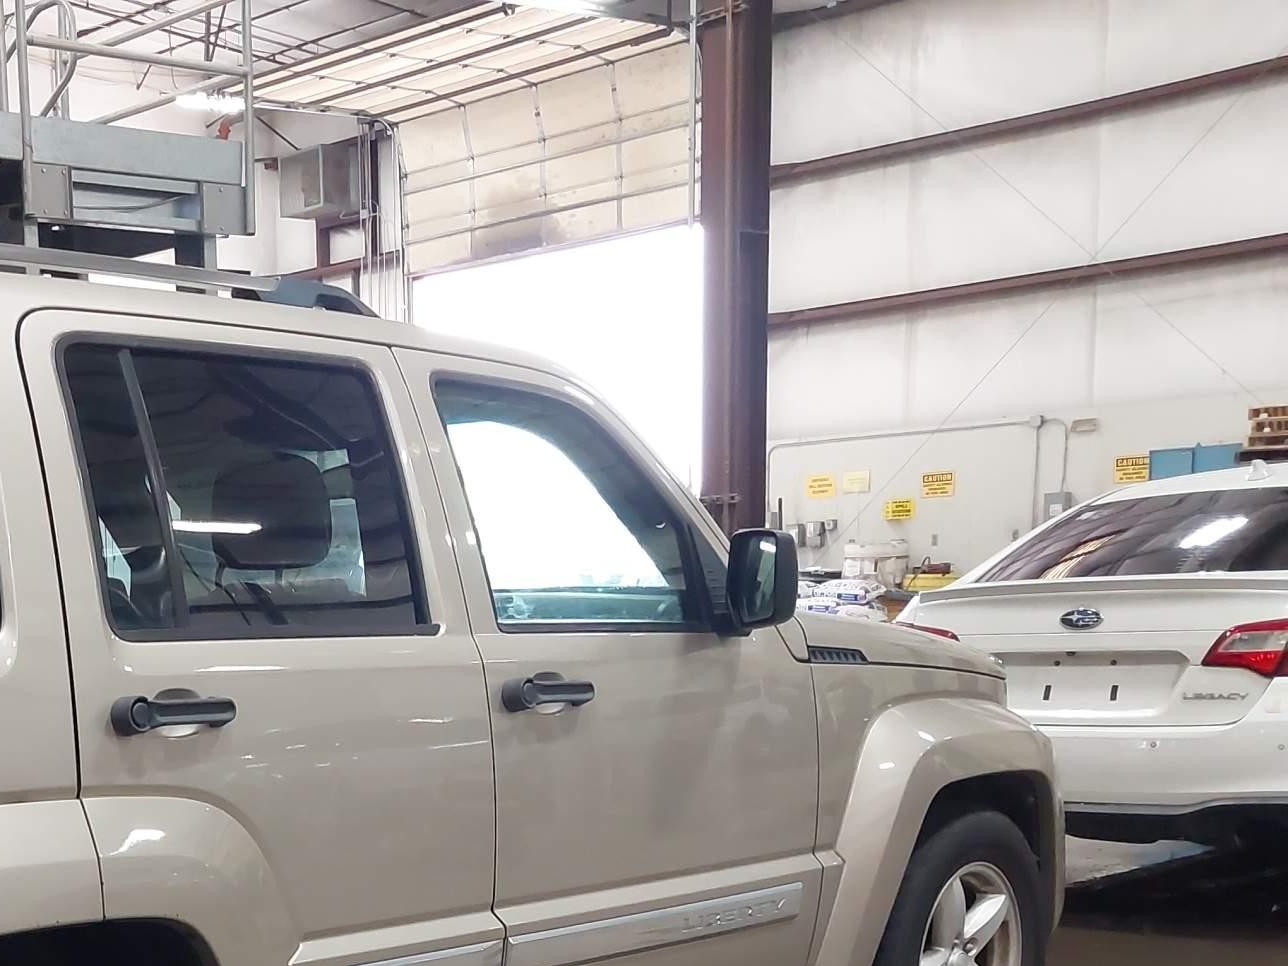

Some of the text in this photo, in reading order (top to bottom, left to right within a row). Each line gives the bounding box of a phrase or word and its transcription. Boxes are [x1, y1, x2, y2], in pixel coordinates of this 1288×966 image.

[1117, 457, 1150, 467] CAUTION
[923, 473, 952, 483] CAUTION
[1182, 692, 1249, 702] LEGACY
